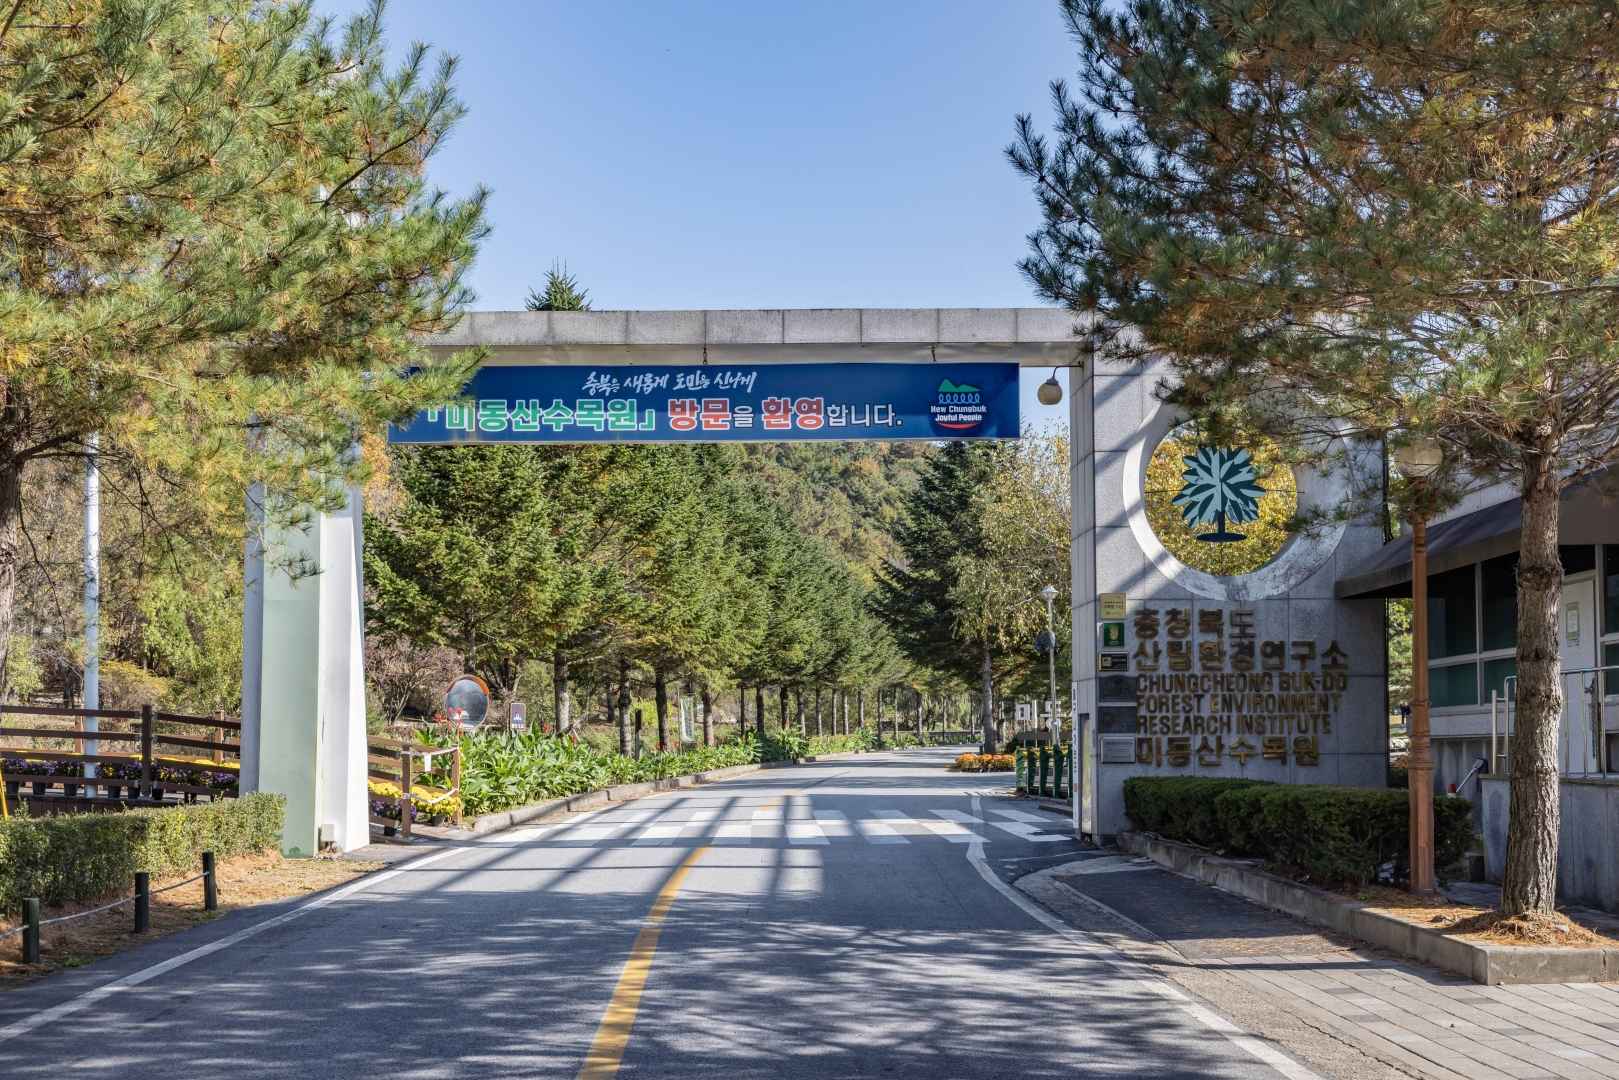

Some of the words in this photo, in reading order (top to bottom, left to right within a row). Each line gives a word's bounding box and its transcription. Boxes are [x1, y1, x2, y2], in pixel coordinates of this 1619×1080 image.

[582, 371, 621, 396] 충북을
[624, 372, 670, 395] 새롭게
[673, 371, 710, 391] 도민을
[714, 370, 758, 393] 신나게
[667, 398, 754, 431] 방문을
[761, 396, 903, 432] 환영합니다.
[930, 405, 946, 414] New
[948, 405, 987, 414] Chungbuk
[935, 414, 957, 423] Joyful
[959, 414, 983, 423] People
[1134, 607, 1256, 640] 충청북도
[1133, 640, 1348, 672] 산림환경연구소
[1136, 672, 1273, 692] CHUNGCHEONG
[1279, 672, 1348, 692] BUK-DO
[1136, 693, 1204, 714] FOREST
[1210, 693, 1343, 714] ENVIRONMENT
[1136, 714, 1231, 735] RESEARCH
[1236, 714, 1332, 735] INSTITUTE
[1136, 735, 1320, 768] 미동산수목원
